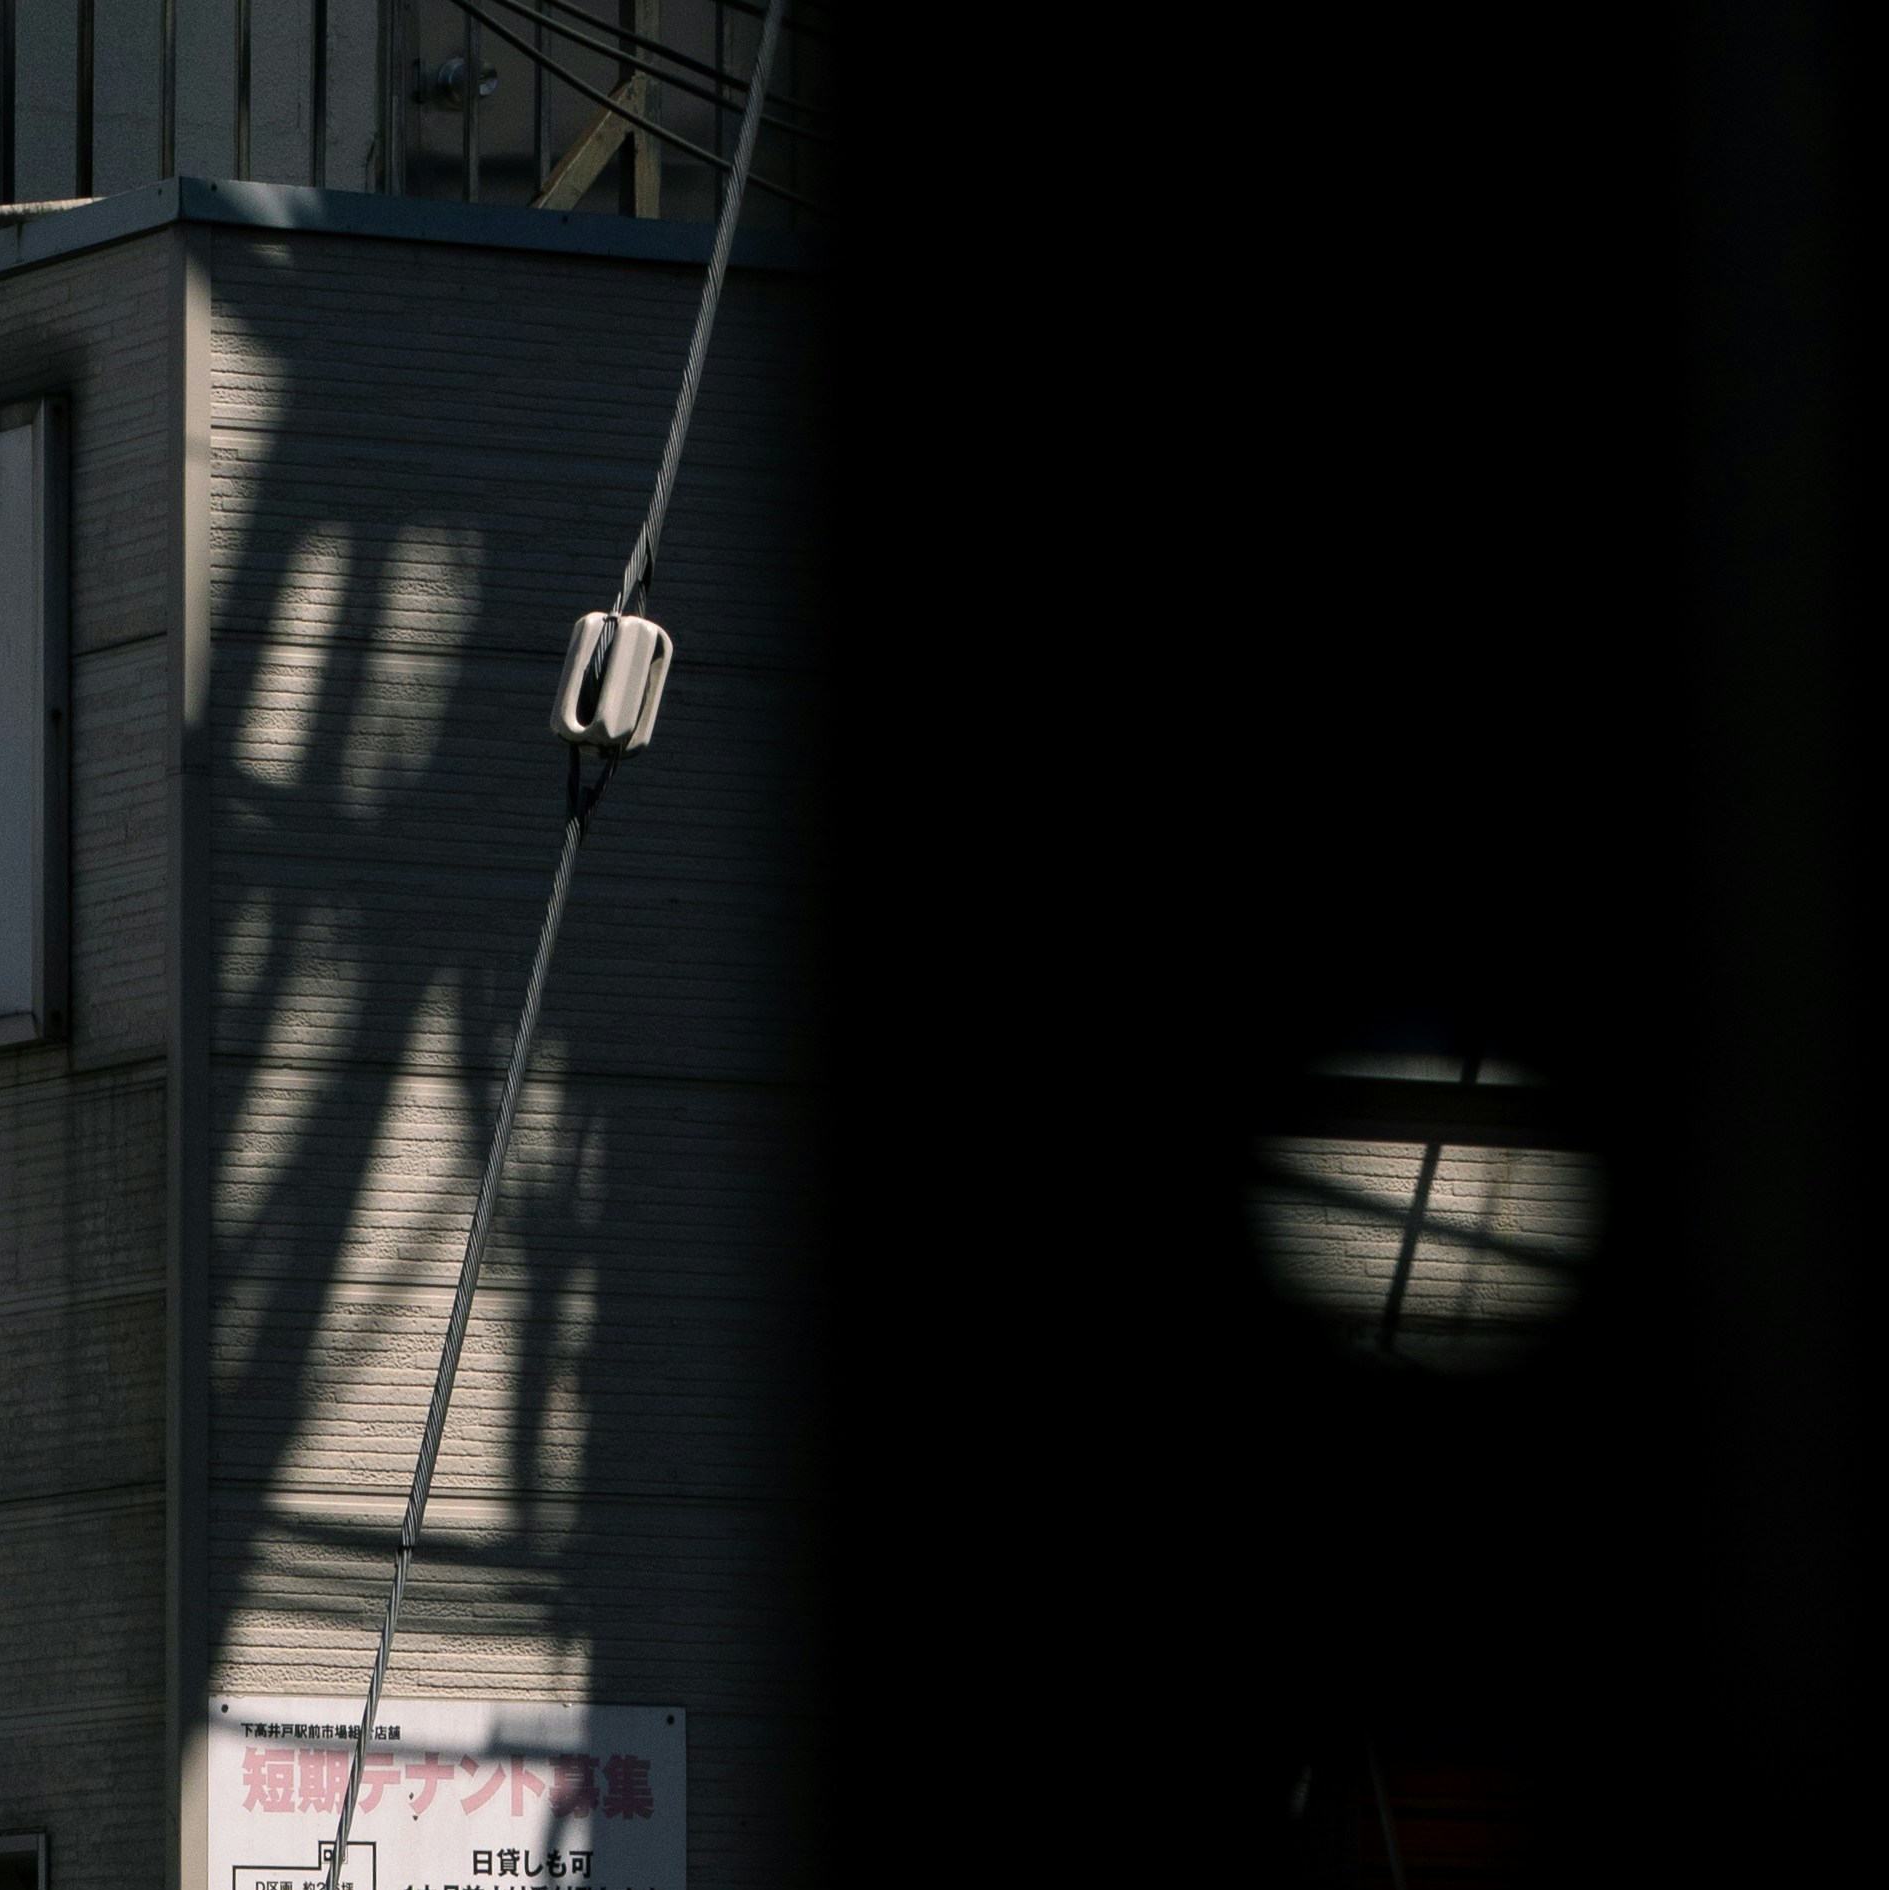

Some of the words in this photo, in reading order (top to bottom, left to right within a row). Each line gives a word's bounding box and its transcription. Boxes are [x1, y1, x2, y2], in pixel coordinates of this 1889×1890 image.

[240, 1722, 401, 1741] 下高井戸駅前市場組店舗
[241, 1746, 655, 1821] 短期テナント募集
[471, 1848, 594, 1878] 日貸しも可
